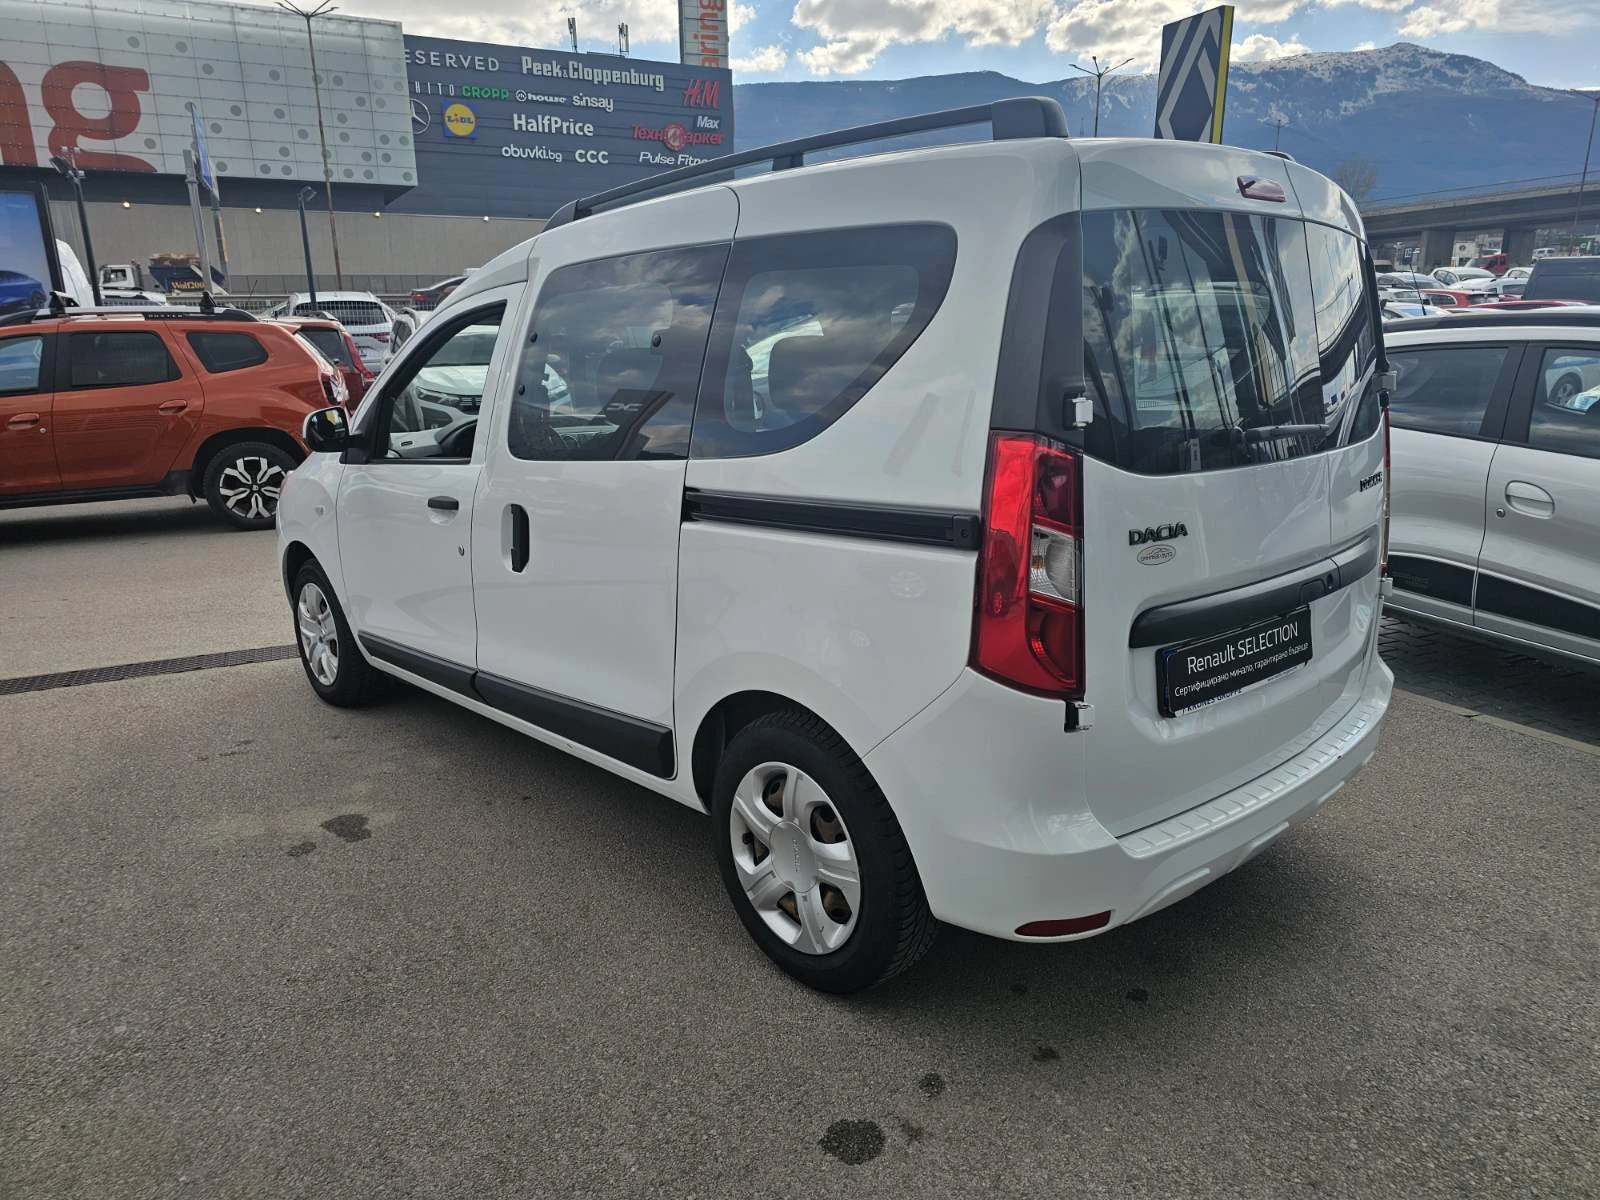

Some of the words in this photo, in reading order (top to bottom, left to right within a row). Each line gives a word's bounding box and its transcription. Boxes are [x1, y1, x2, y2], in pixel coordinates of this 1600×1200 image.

[462, 85, 510, 99] CROPP
[572, 92, 614, 112] sinsay
[682, 79, 720, 110] H&M
[513, 113, 594, 137] HalfPrice
[696, 115, 720, 129] Max
[502, 144, 563, 162] obuvki.bg
[639, 151, 674, 165] Pulse
[1128, 522, 1188, 546] DACIA
[1187, 643, 1235, 674] Renault
[1237, 621, 1298, 658] SELECTION
[1174, 672, 1229, 697] Сертифицирано
